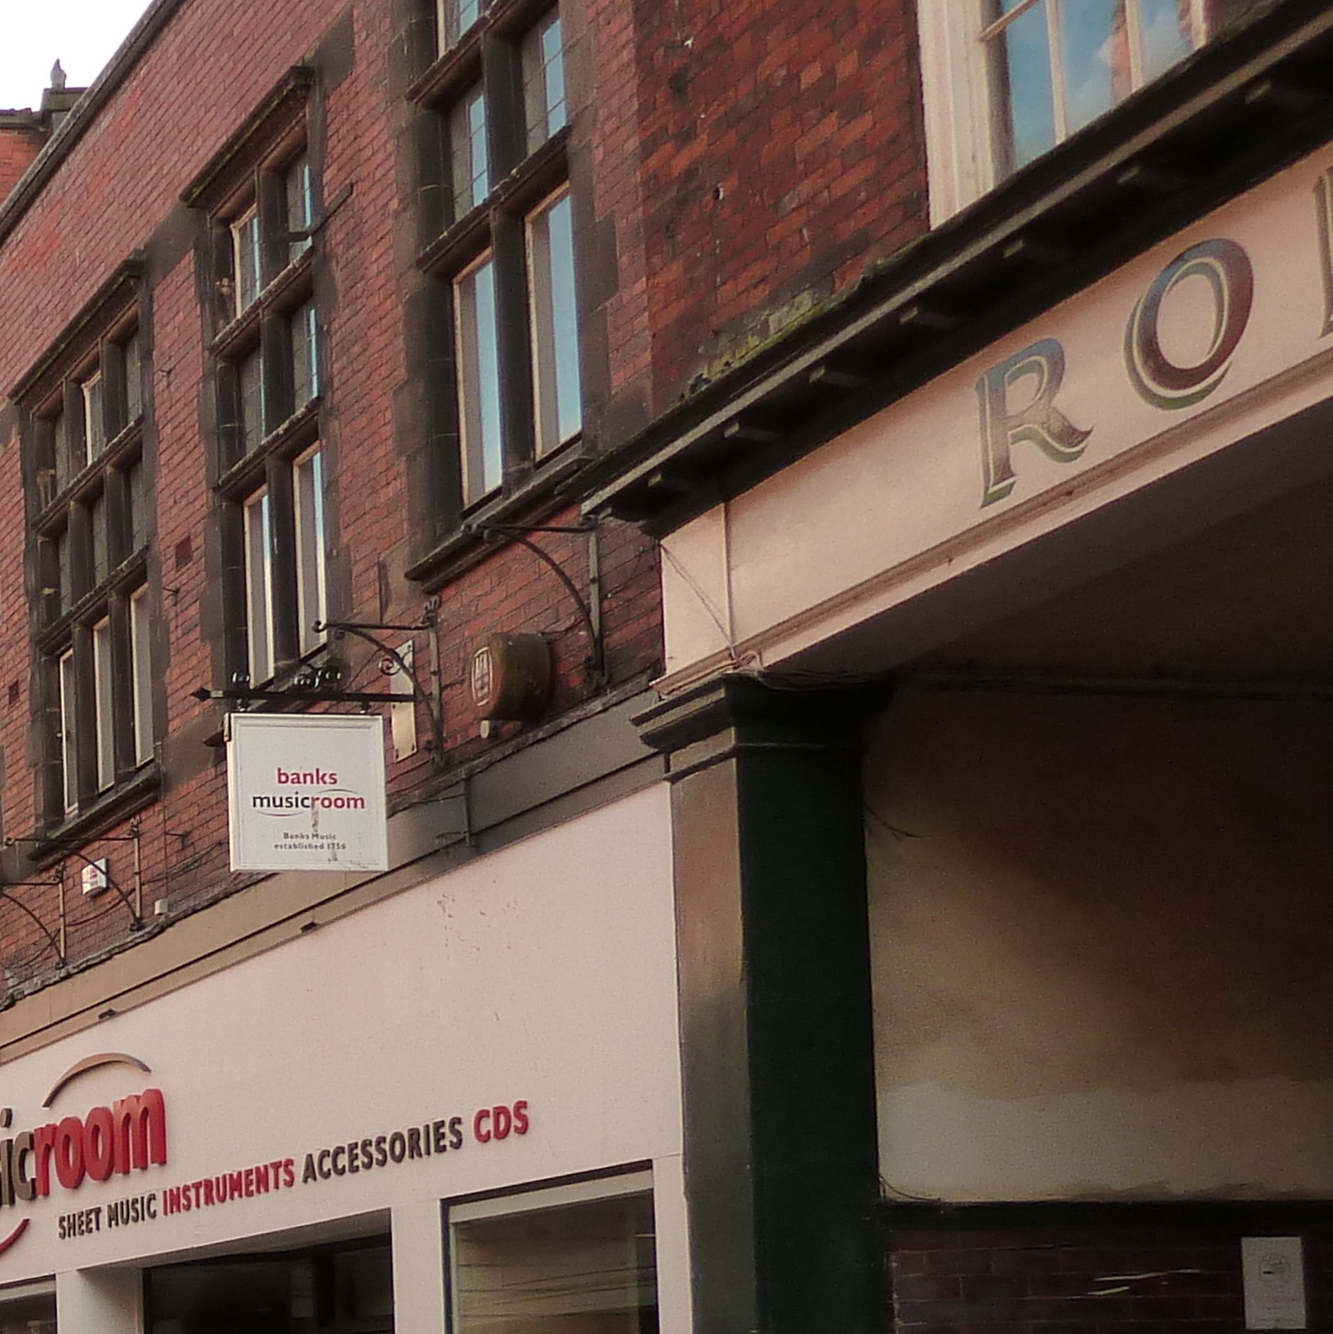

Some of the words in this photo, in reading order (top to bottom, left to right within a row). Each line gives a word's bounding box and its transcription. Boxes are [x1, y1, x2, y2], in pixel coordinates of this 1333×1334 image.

[975, 165, 1333, 510] RO
[277, 767, 338, 785] banks
[252, 790, 366, 810] musicroom
[283, 832, 310, 840] Banks
[311, 832, 337, 840] Music
[274, 842, 324, 850] established
[58, 1206, 102, 1240] SHEET
[106, 1192, 157, 1229] MUSIC
[162, 1157, 296, 1216] INSTRUMENTS
[302, 1116, 463, 1184] ACCESSORIES
[473, 1100, 530, 1144] CDS
